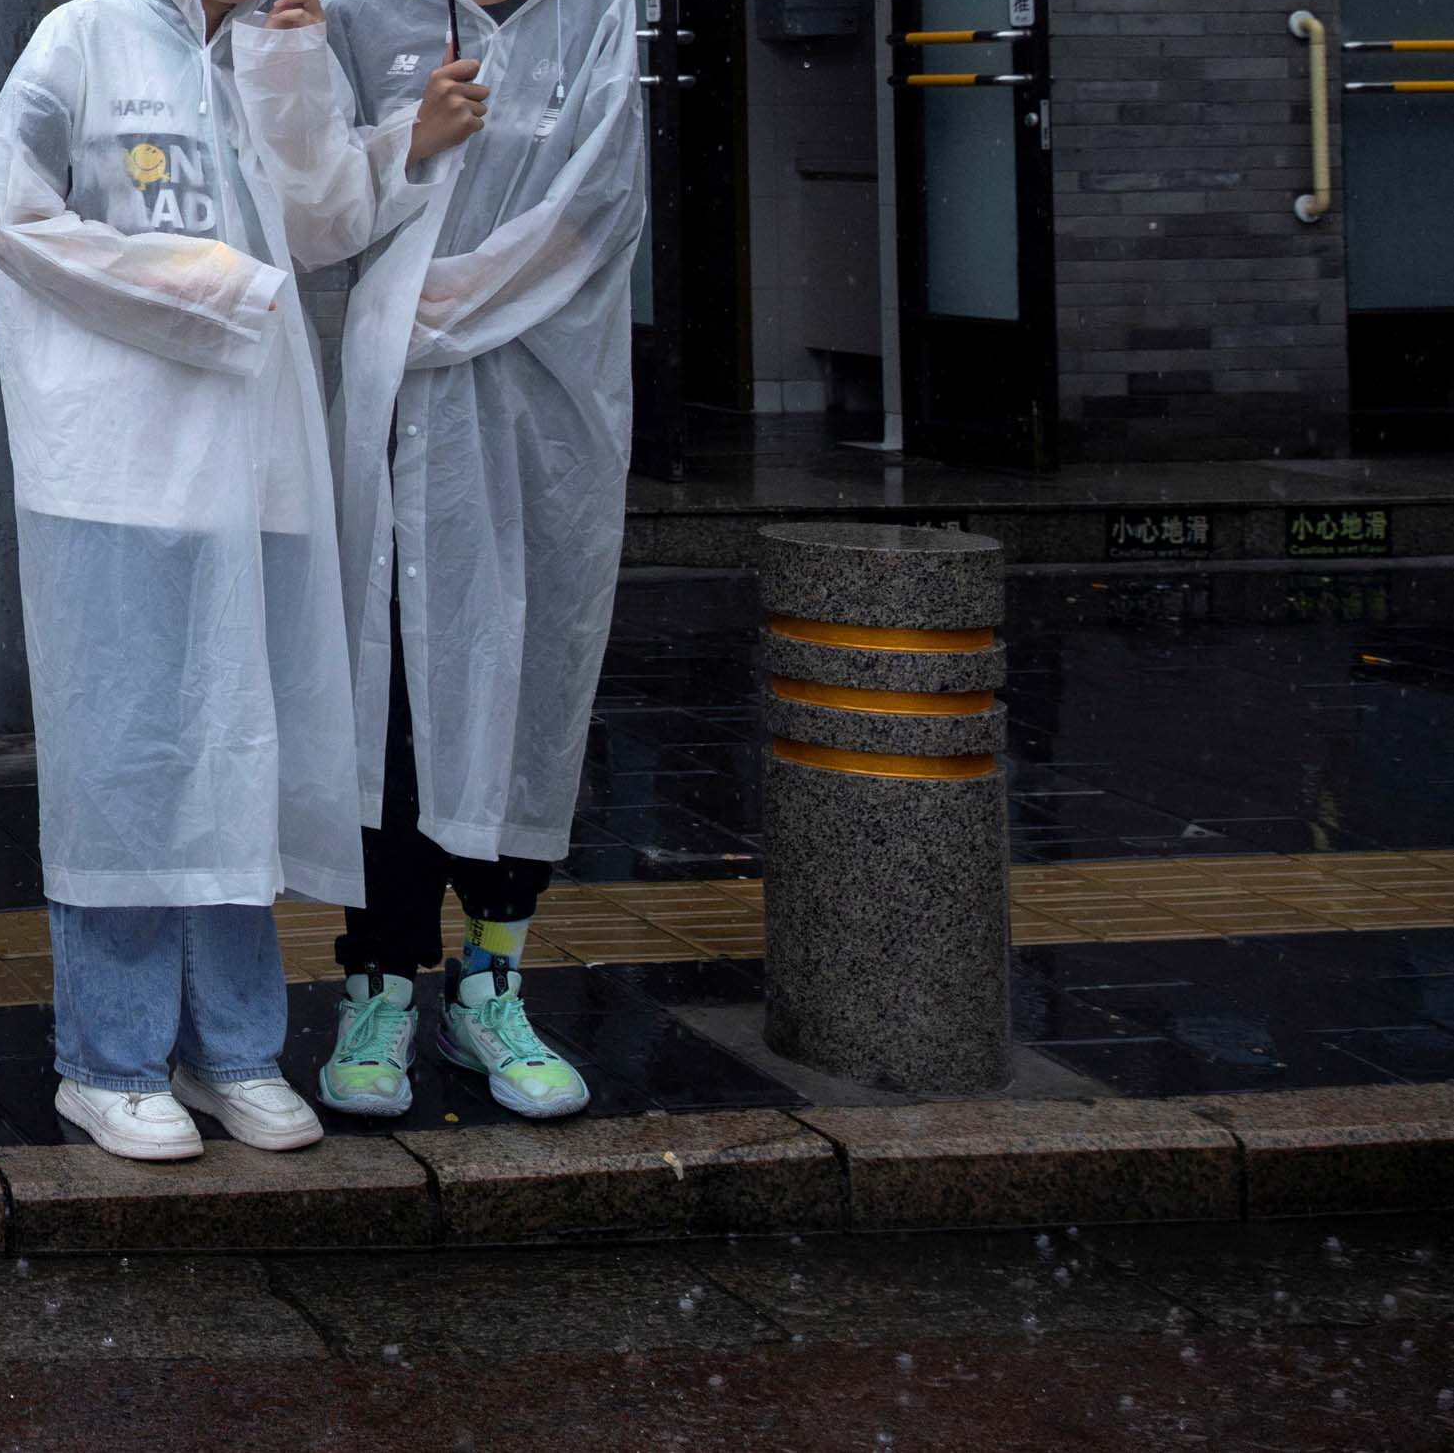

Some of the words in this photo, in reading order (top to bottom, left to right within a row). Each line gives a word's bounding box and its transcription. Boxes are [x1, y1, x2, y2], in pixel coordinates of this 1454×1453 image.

[110, 99, 175, 117] HAPPY
[1110, 514, 1210, 545] 小心地滑
[1289, 510, 1390, 541] 小心地滑
